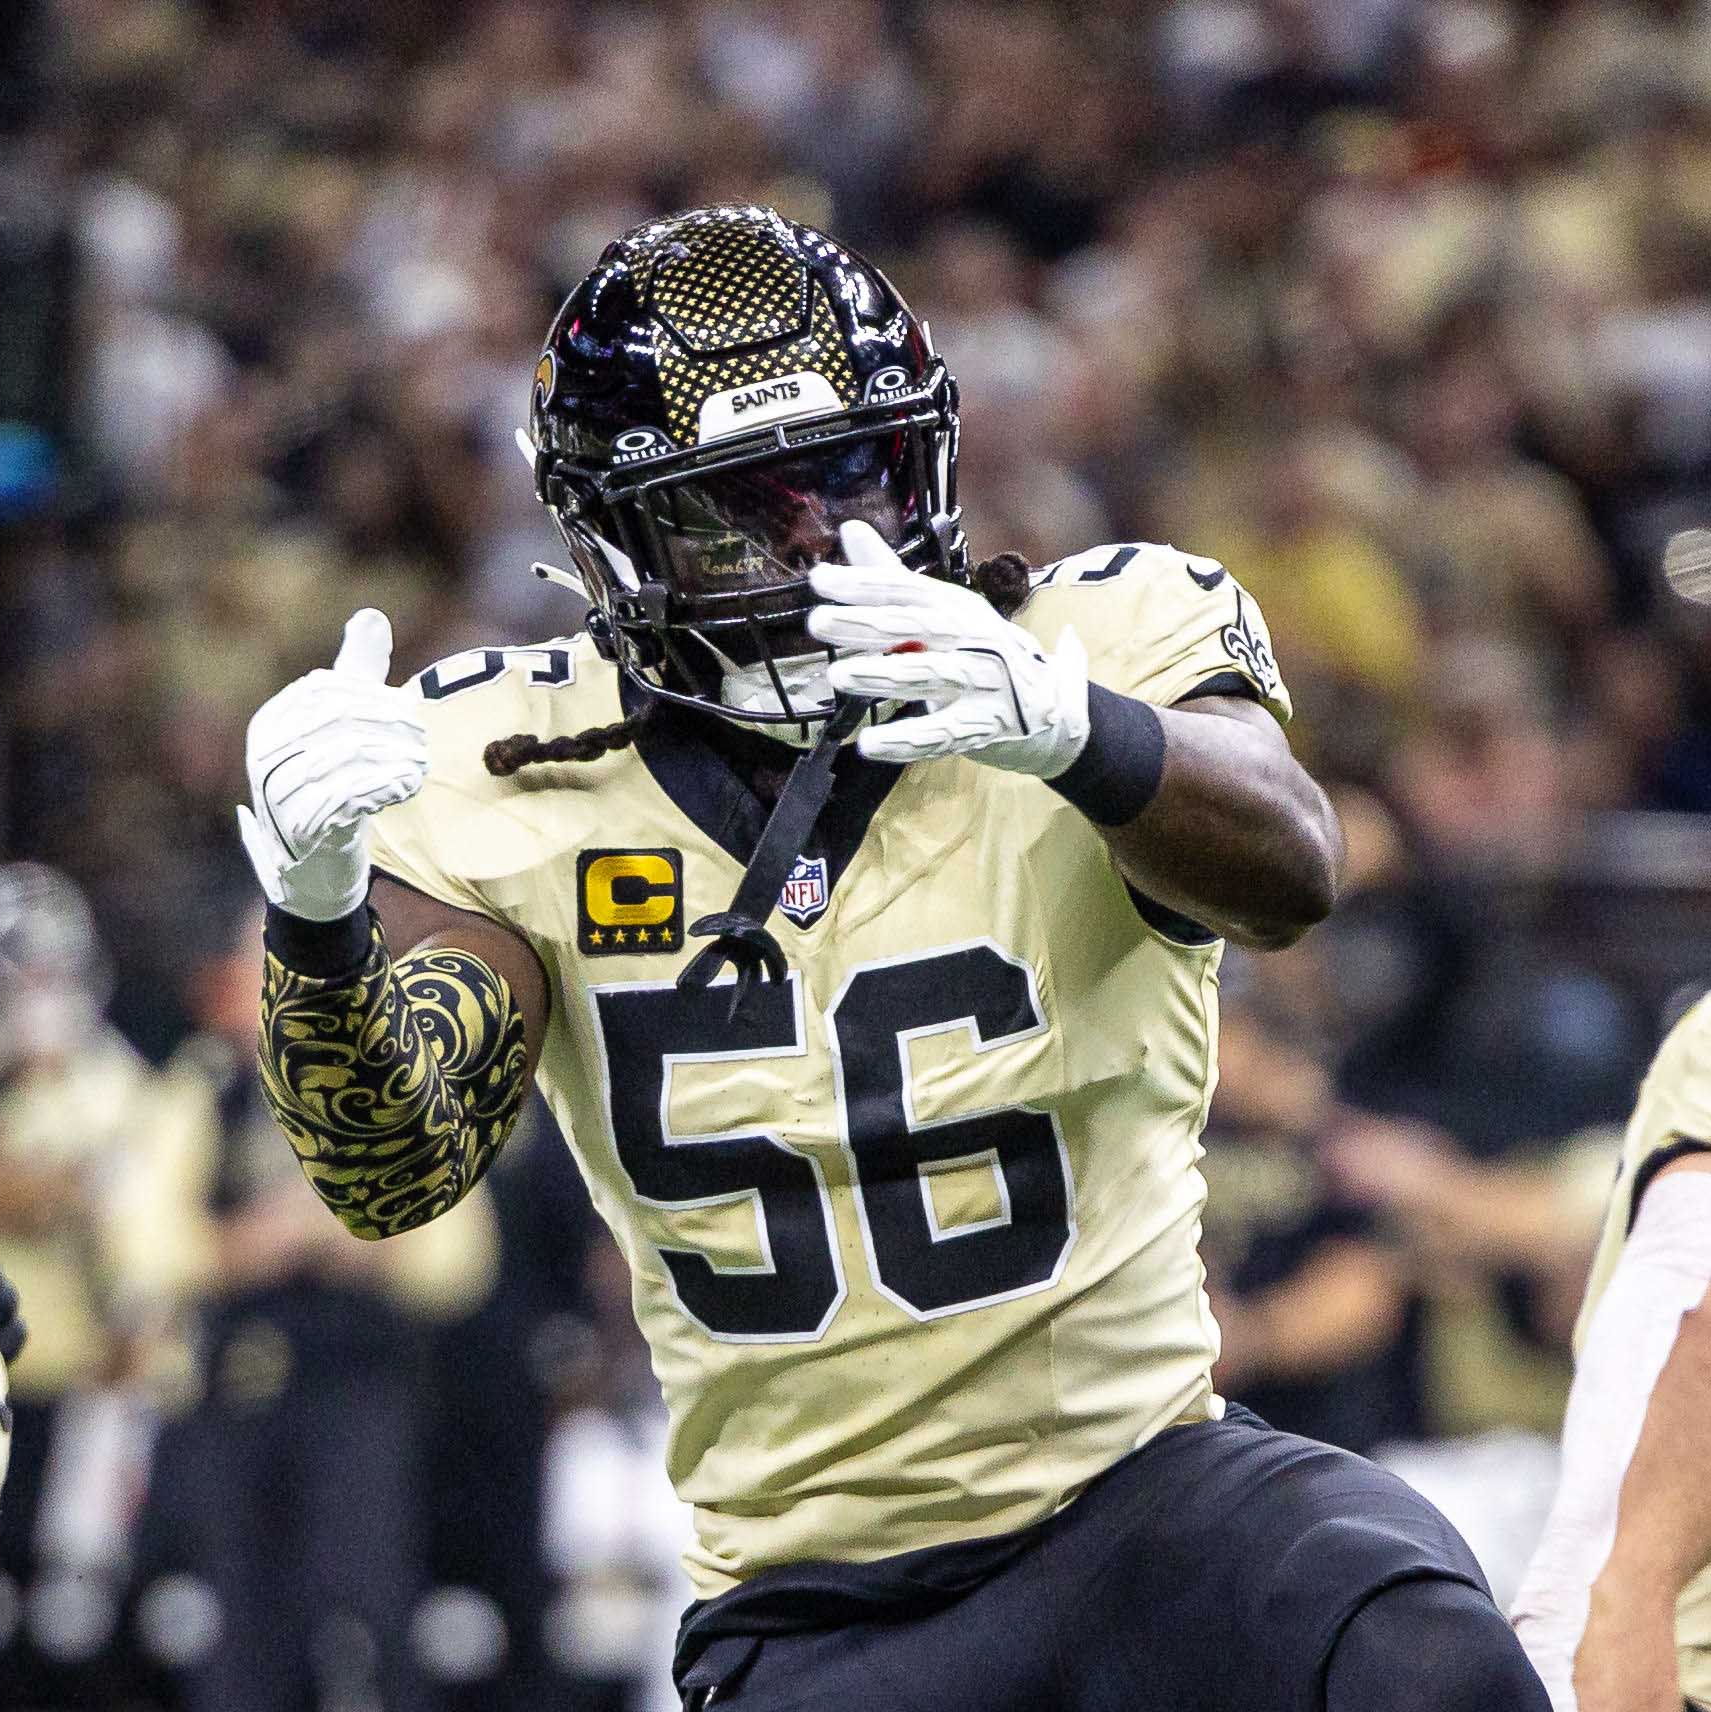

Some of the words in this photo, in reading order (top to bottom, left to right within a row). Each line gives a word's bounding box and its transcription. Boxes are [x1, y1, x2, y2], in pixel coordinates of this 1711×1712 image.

[731, 380, 801, 413] SAINTS
[612, 445, 669, 464] OAKLEY
[586, 855, 675, 926] C
[784, 882, 821, 908] NFL
[587, 934, 1078, 1344] 56
